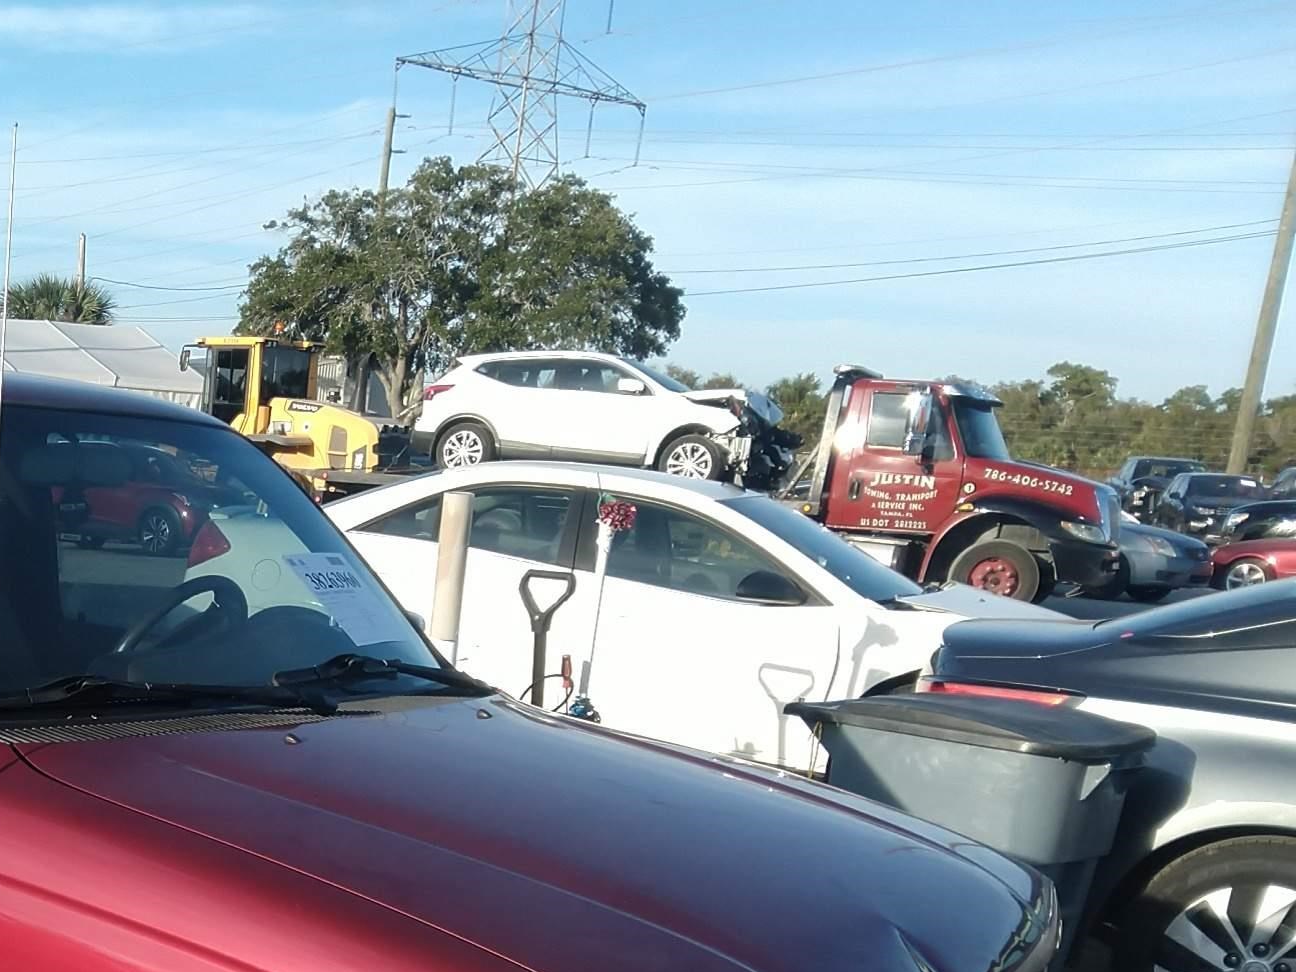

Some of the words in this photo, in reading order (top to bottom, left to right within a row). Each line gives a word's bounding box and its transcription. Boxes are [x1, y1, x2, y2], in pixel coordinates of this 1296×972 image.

[870, 472, 936, 489] JUSTIN
[984, 468, 1073, 496] 786-406-5742
[895, 489, 938, 501] TRANSPORT
[877, 501, 906, 510] SERVICE
[909, 502, 925, 511] INC.
[872, 518, 890, 527] DOT
